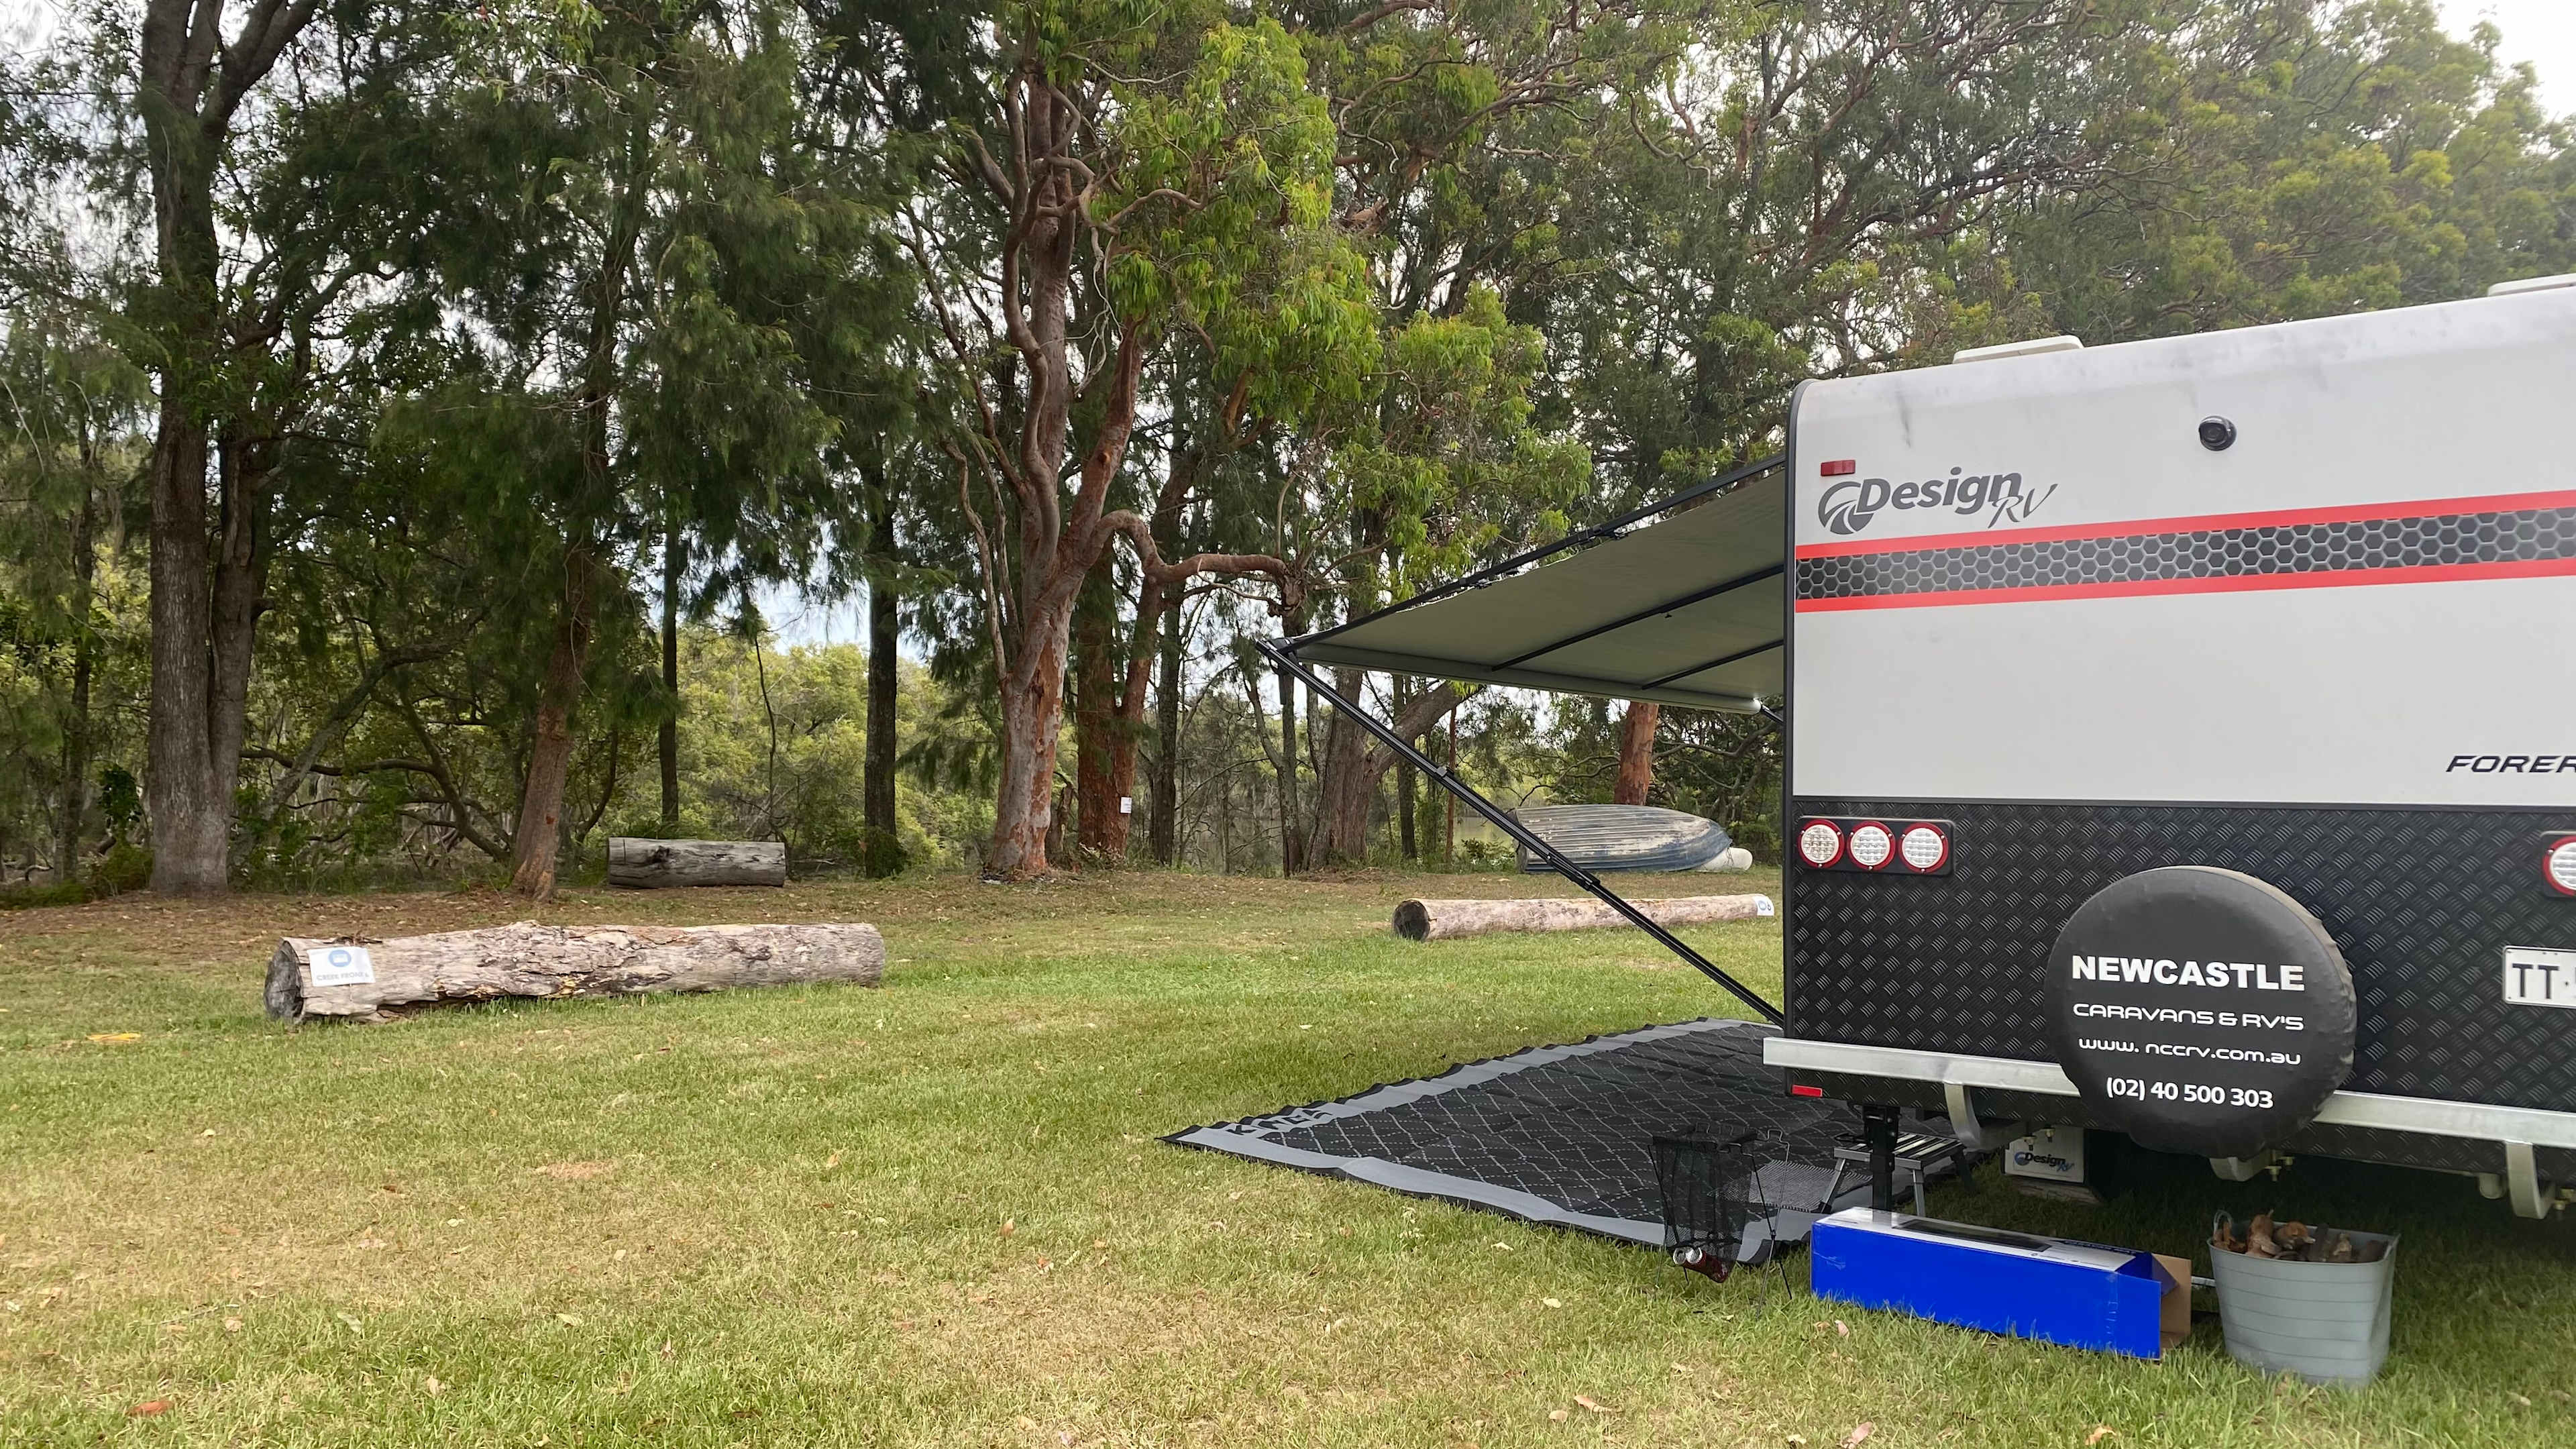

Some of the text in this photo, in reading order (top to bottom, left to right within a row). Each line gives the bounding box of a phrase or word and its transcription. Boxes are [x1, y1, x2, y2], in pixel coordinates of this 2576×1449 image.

[1856, 466, 2059, 529] Design RV
[2072, 955, 2306, 991] NEWCASTLE
[2073, 1003, 2304, 1031] CARAVANS & RV'S
[2079, 1038, 2301, 1065] www. nccrv.com.au
[2106, 1076, 2274, 1109] (02) 40 500 303
[2025, 1152, 2065, 1167] Design
